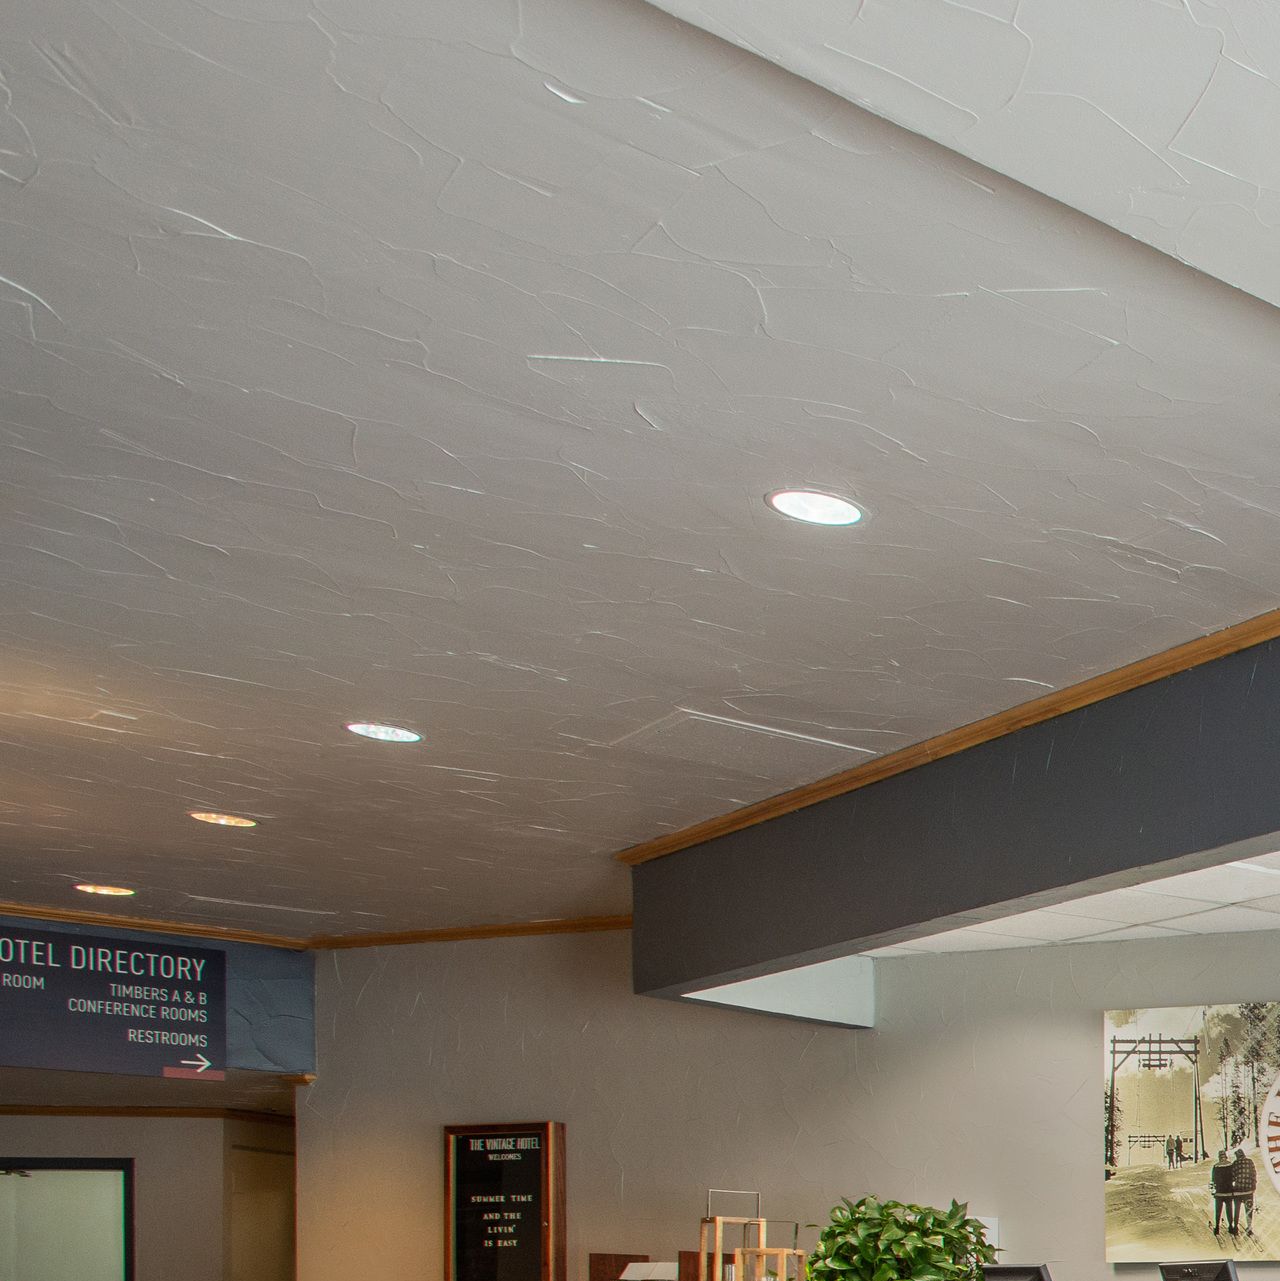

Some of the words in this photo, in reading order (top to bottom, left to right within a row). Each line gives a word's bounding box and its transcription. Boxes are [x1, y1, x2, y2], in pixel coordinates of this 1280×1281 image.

[70, 945, 206, 981] DIRECTORY
[2, 974, 45, 990] ROOM
[110, 983, 169, 1002] TIMBERS
[172, 990, 181, 1004] A
[184, 991, 198, 1004] &
[199, 992, 207, 1005] B
[68, 998, 157, 1019] CONFERENCE
[161, 1006, 208, 1023] ROOMS
[128, 1029, 208, 1048] RESTROOMS
[470, 1138, 484, 1151] THE
[485, 1138, 516, 1151] VINTAGE
[517, 1137, 541, 1150] HOTEL
[471, 1195, 505, 1203] SUMMER
[503, 1212, 522, 1220] THE
[497, 1239, 518, 1247] EASY
